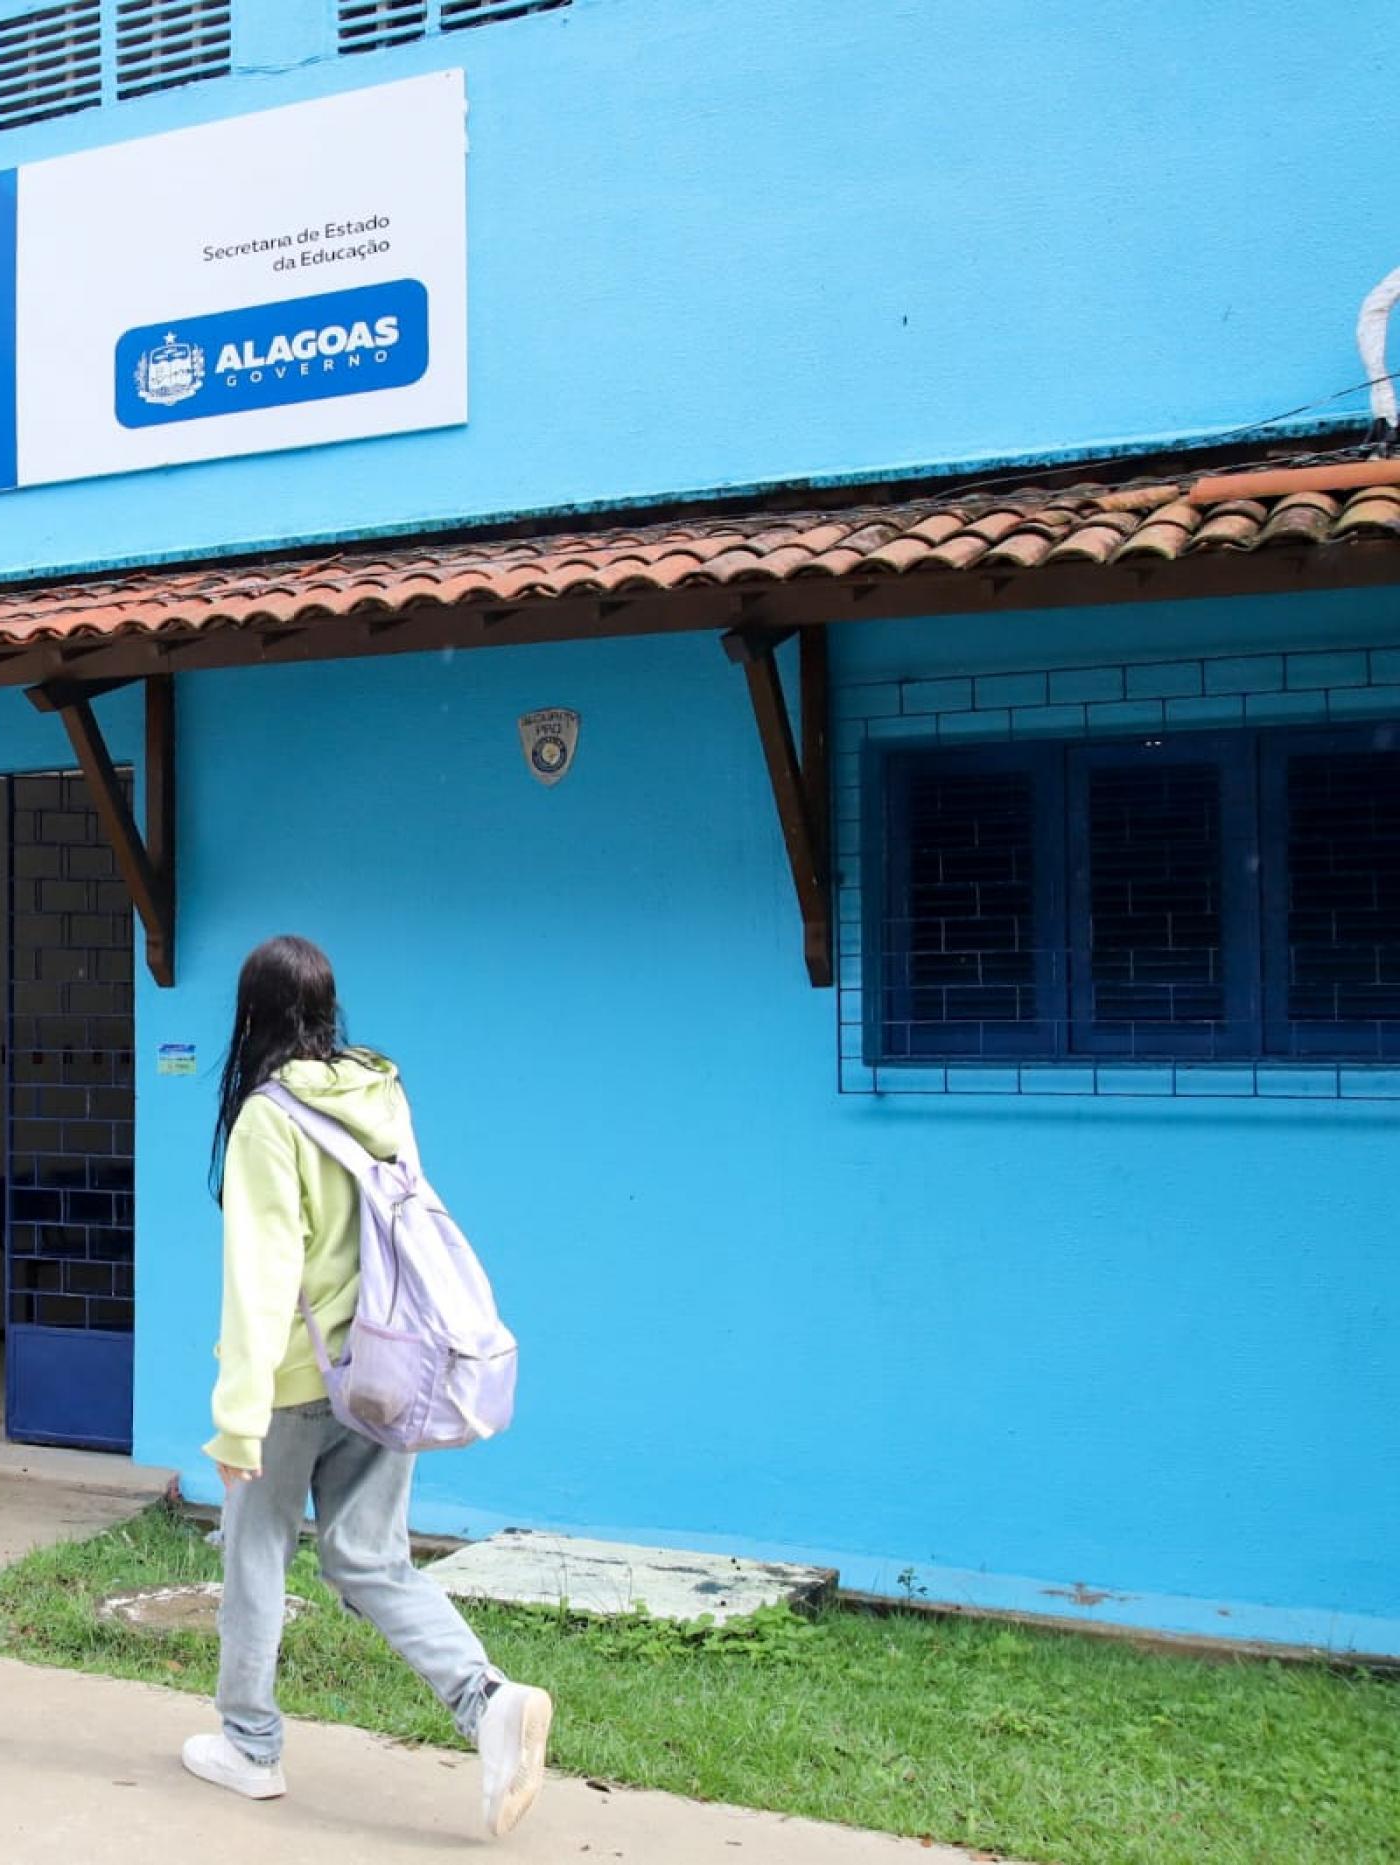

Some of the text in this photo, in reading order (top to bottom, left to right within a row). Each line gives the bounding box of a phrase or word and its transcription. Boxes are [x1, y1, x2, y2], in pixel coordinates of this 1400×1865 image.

[203, 215, 390, 261] Secretaria de Estado
[272, 239, 390, 272] da Educação
[216, 316, 399, 374] ALAGOAS
[227, 351, 387, 387] GOVERNO
